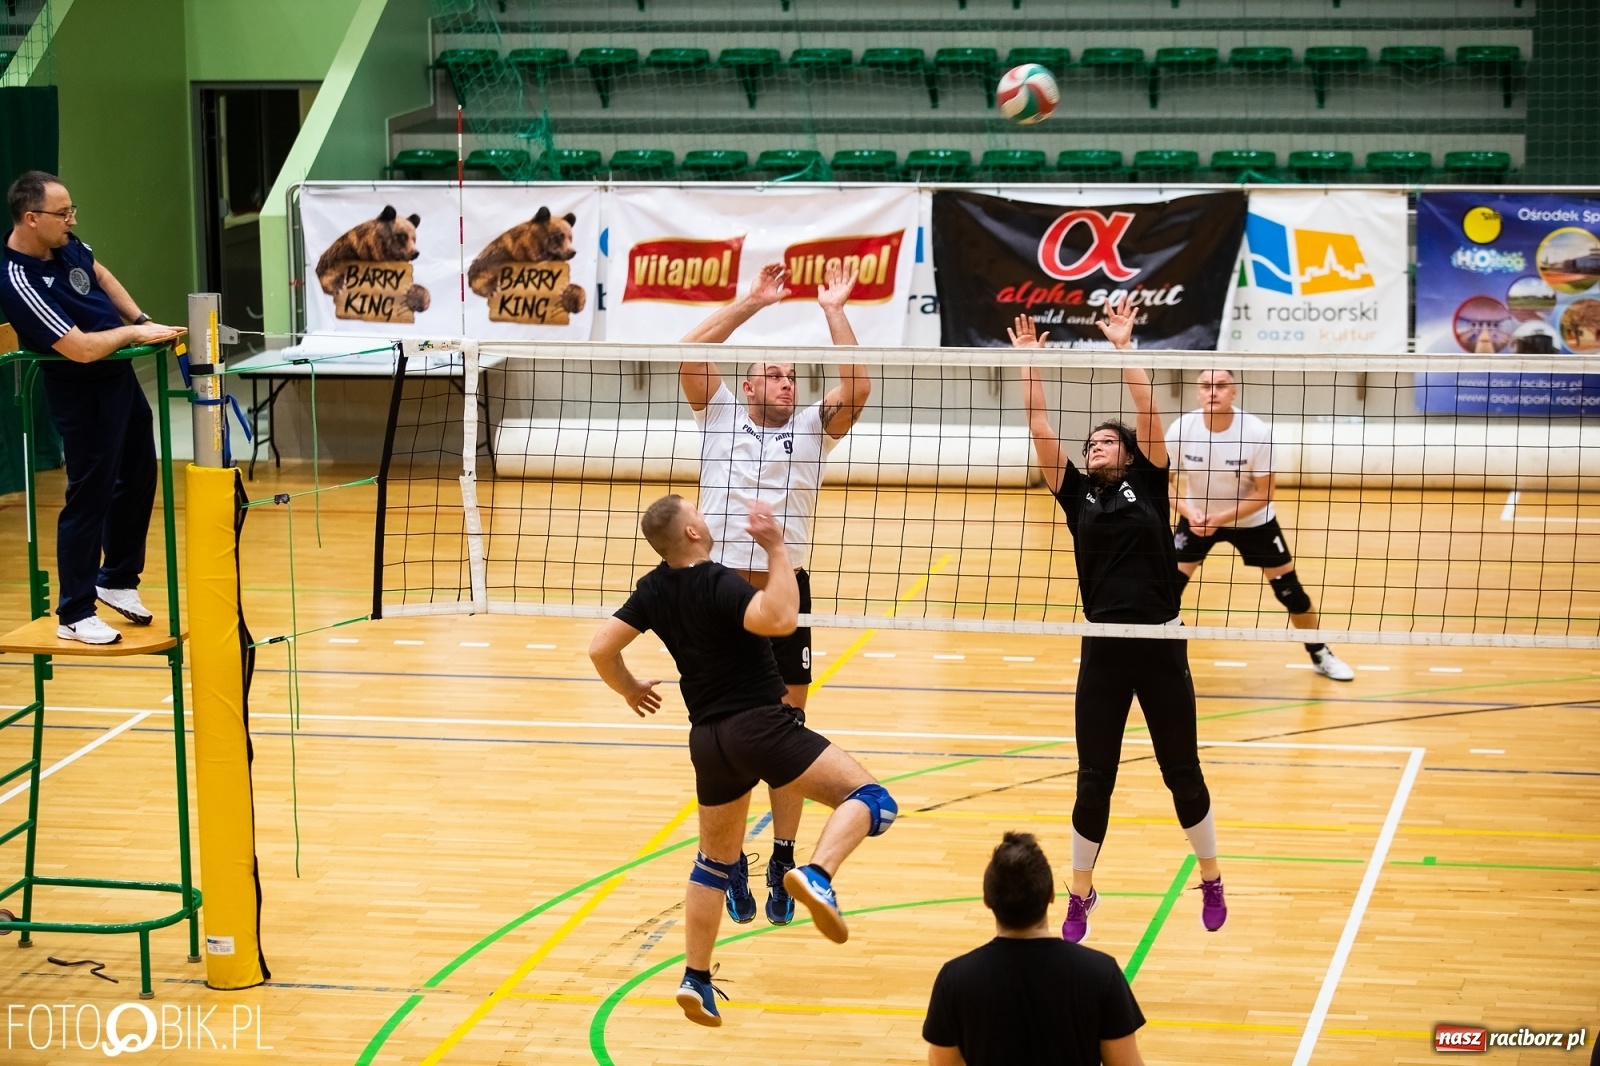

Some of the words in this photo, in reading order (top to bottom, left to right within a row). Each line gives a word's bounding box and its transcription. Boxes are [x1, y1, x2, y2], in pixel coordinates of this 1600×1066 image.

[1517, 207, 1580, 222] Ośrodek
[345, 265, 406, 291] BARRY
[500, 265, 562, 291] BARRY
[343, 294, 396, 321] KING
[497, 294, 551, 321] KING
[995, 280, 1085, 309] alpha
[1086, 283, 1185, 313] spirit
[1066, 311, 1098, 325] and
[1266, 301, 1378, 322] raciborski
[1257, 330, 1305, 341] oaza
[783, 439, 794, 455] 9
[1273, 535, 1285, 554] 1
[801, 646, 811, 670] 9
